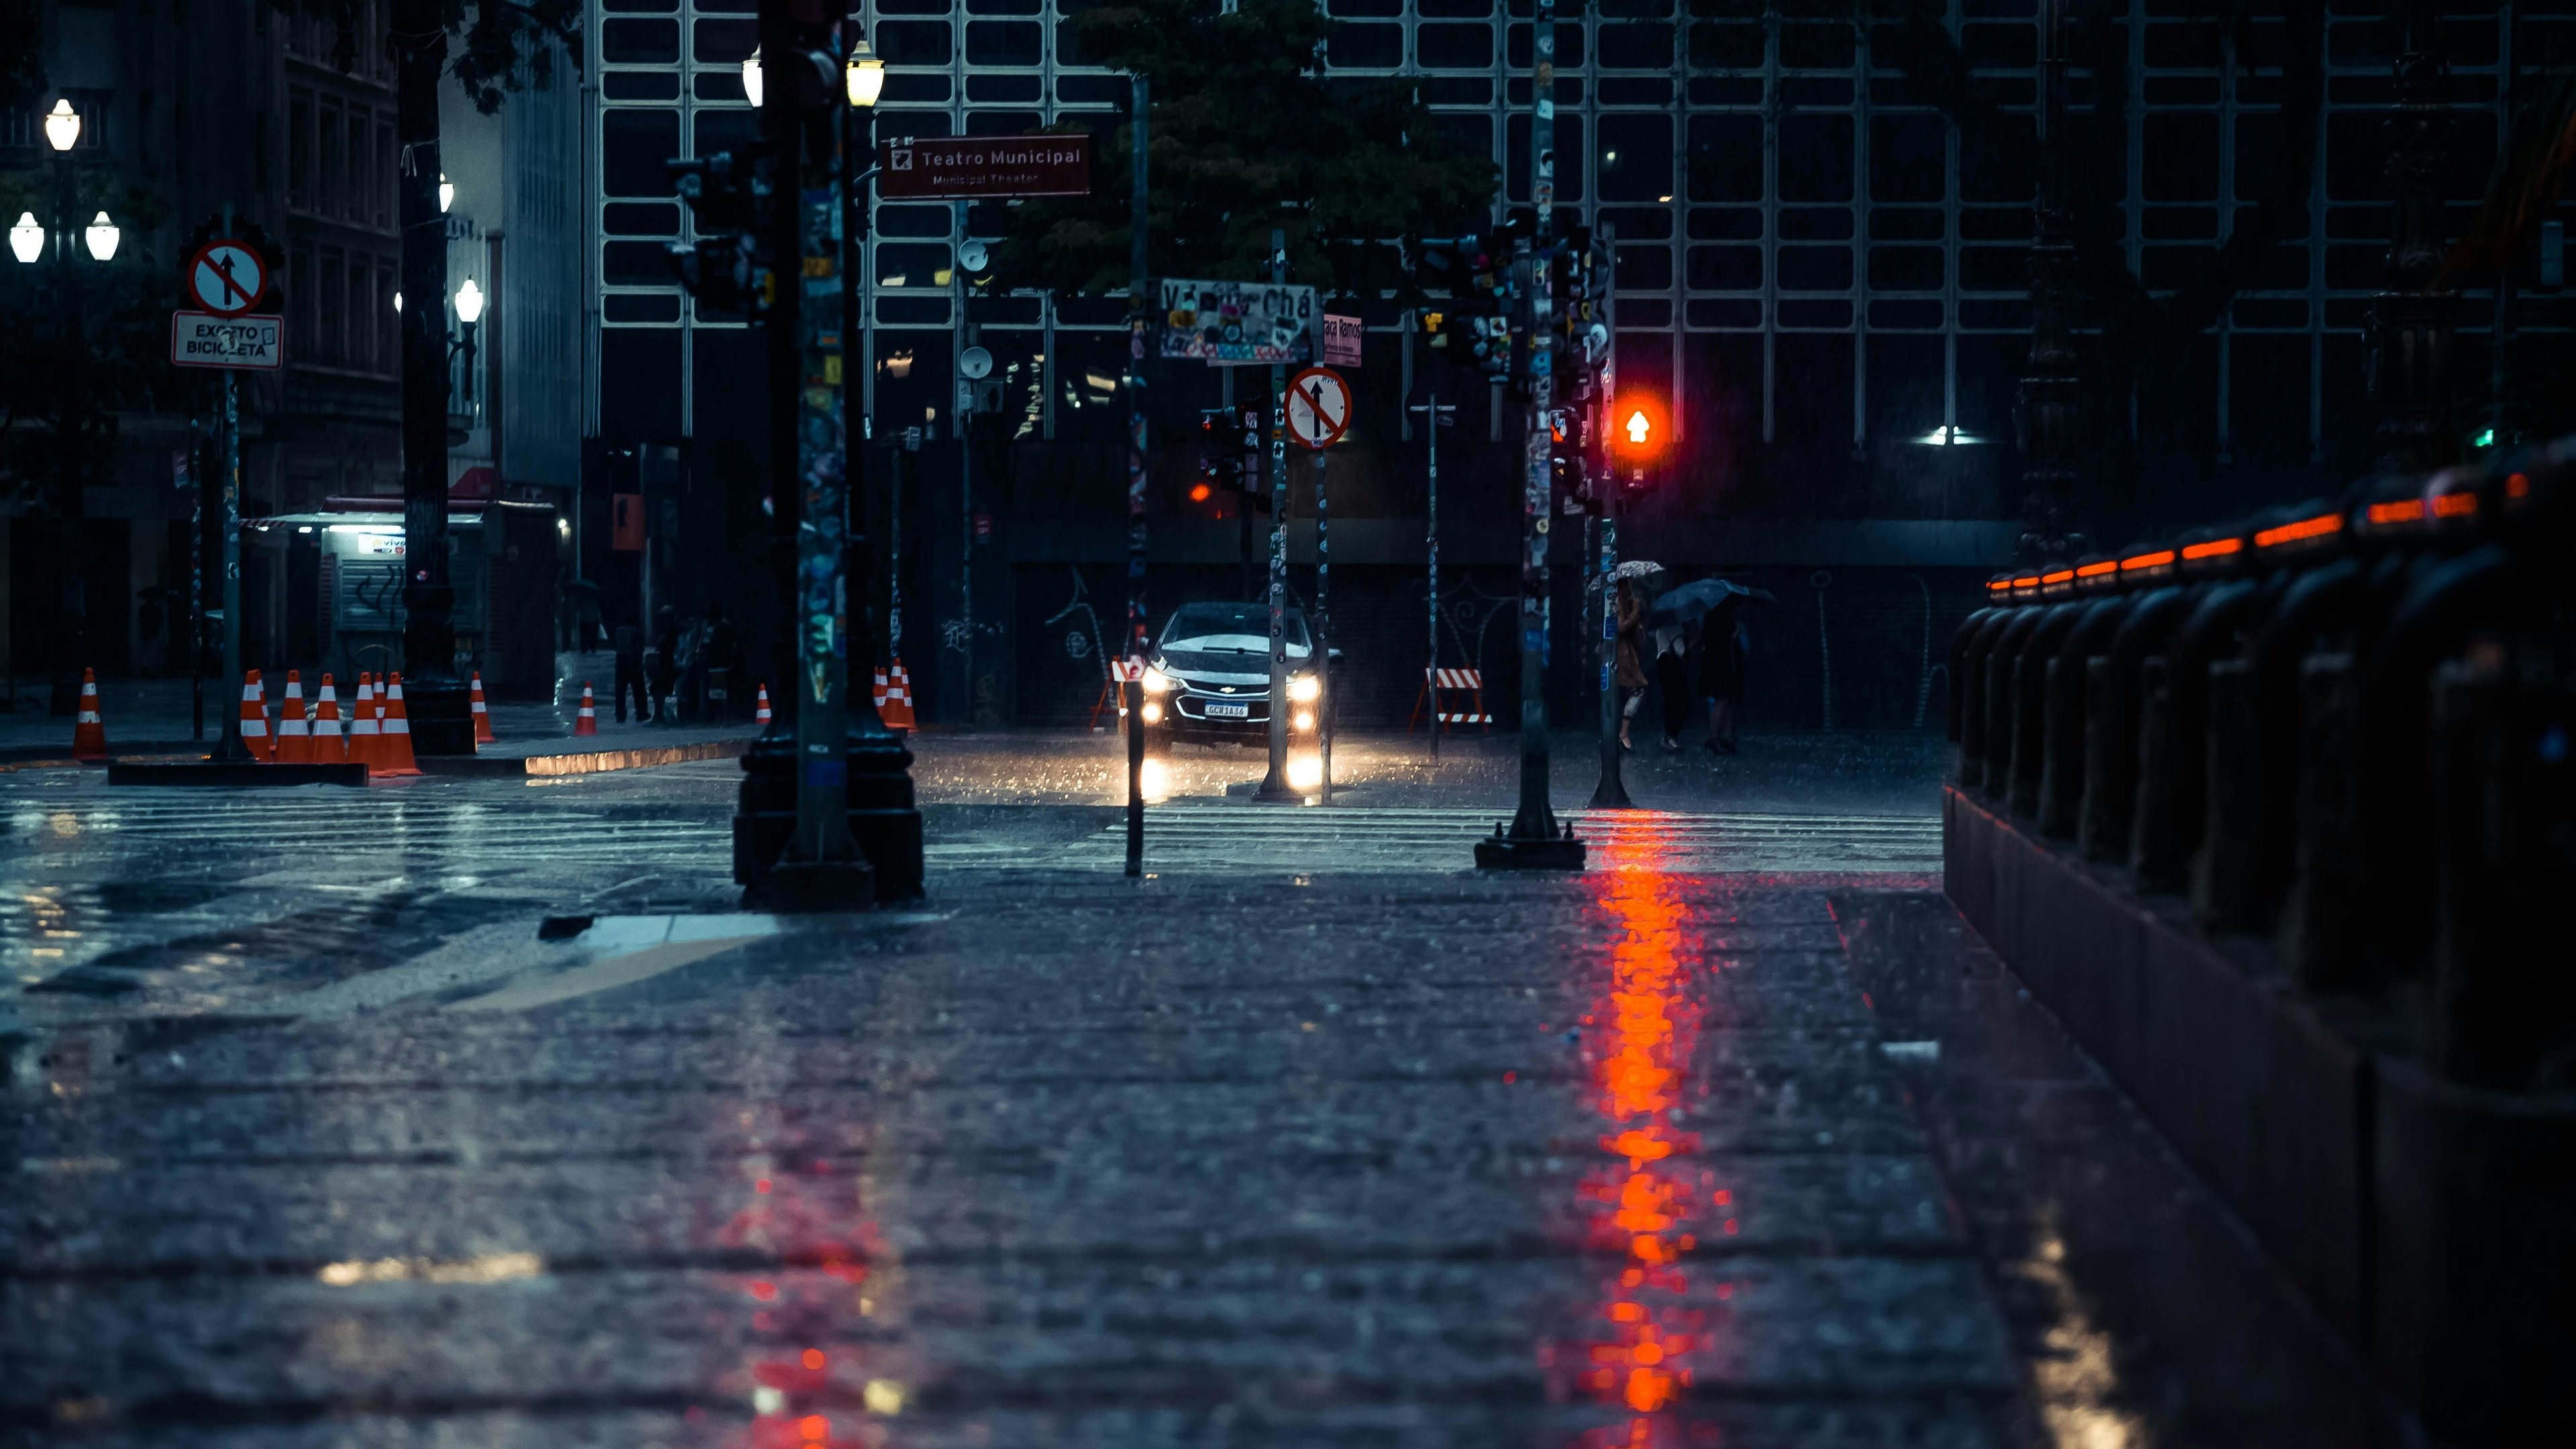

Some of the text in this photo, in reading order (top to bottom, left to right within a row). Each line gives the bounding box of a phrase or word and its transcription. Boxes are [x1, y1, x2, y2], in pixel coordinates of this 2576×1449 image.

[922, 149, 1081, 166] Teatro Municipal
[933, 173, 1038, 186] Municipal Theater
[1263, 287, 1311, 318] Chá
[1339, 318, 1361, 339] Ramos
